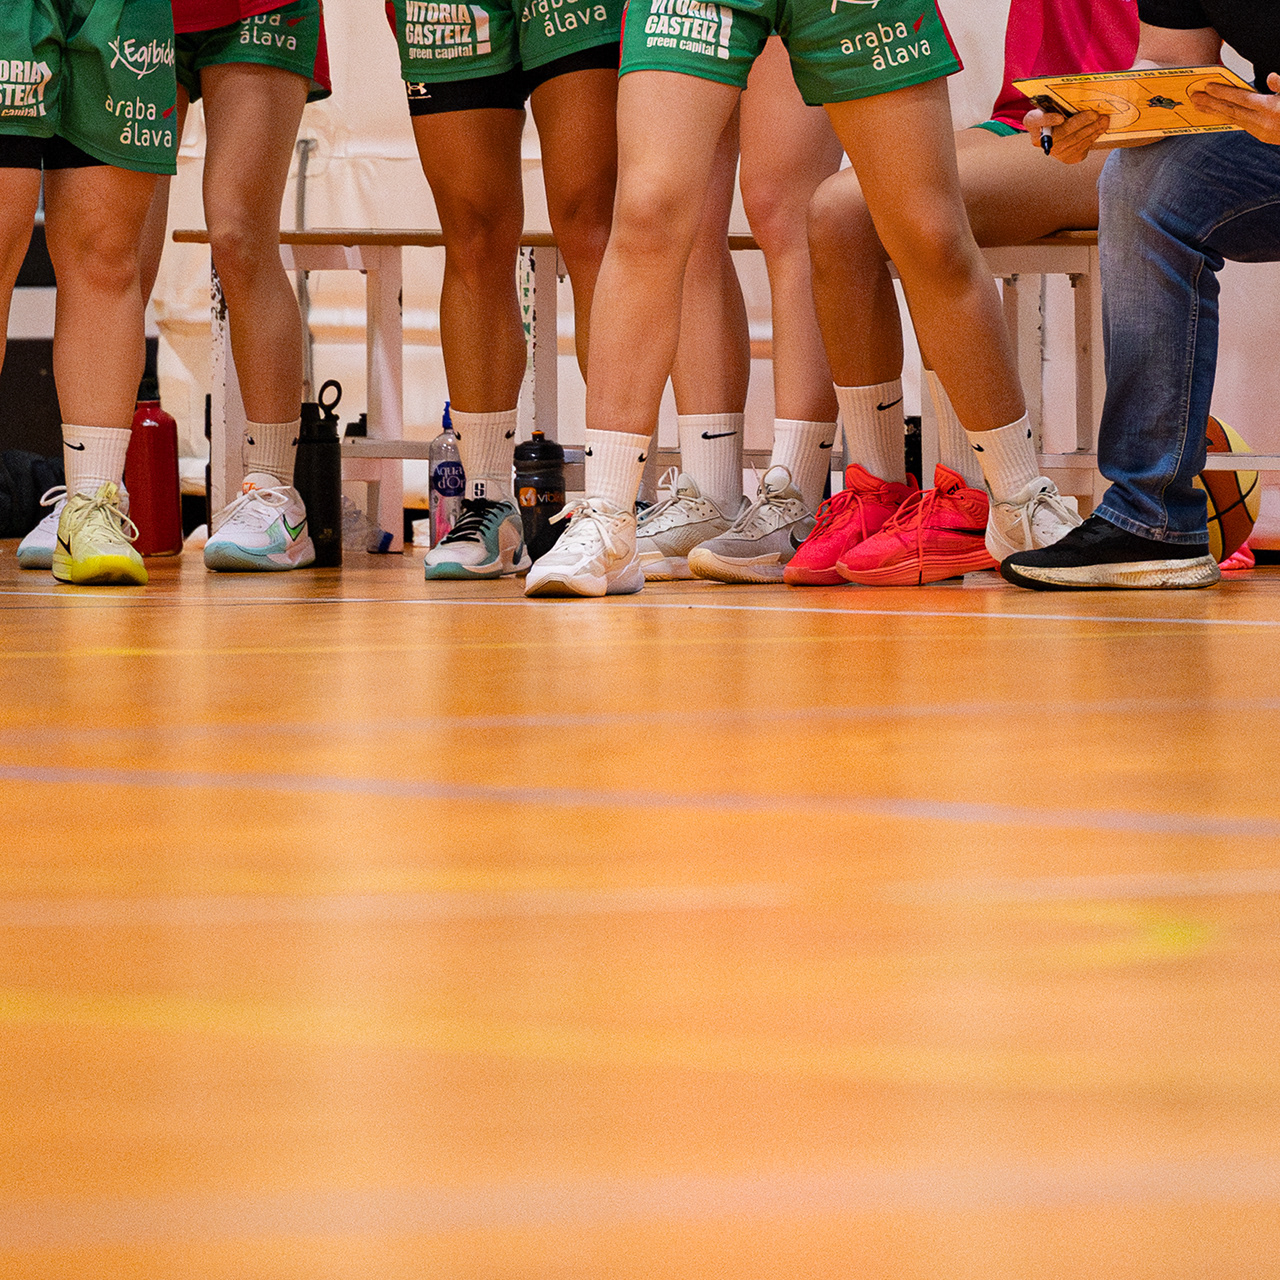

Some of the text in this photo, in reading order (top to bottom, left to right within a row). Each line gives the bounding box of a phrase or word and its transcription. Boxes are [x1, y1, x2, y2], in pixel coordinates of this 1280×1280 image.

[405, 0, 472, 24] VITORIA
[544, 4, 607, 37] álava
[240, 25, 297, 51] álava
[405, 22, 472, 46] GASTEIZ
[645, 15, 717, 44] GASTEIZ
[841, 21, 908, 55] araba
[409, 44, 473, 60] green capital
[646, 36, 716, 58] green capital
[872, 37, 931, 71] álava
[105, 94, 156, 121] araba
[120, 121, 172, 148] álava
